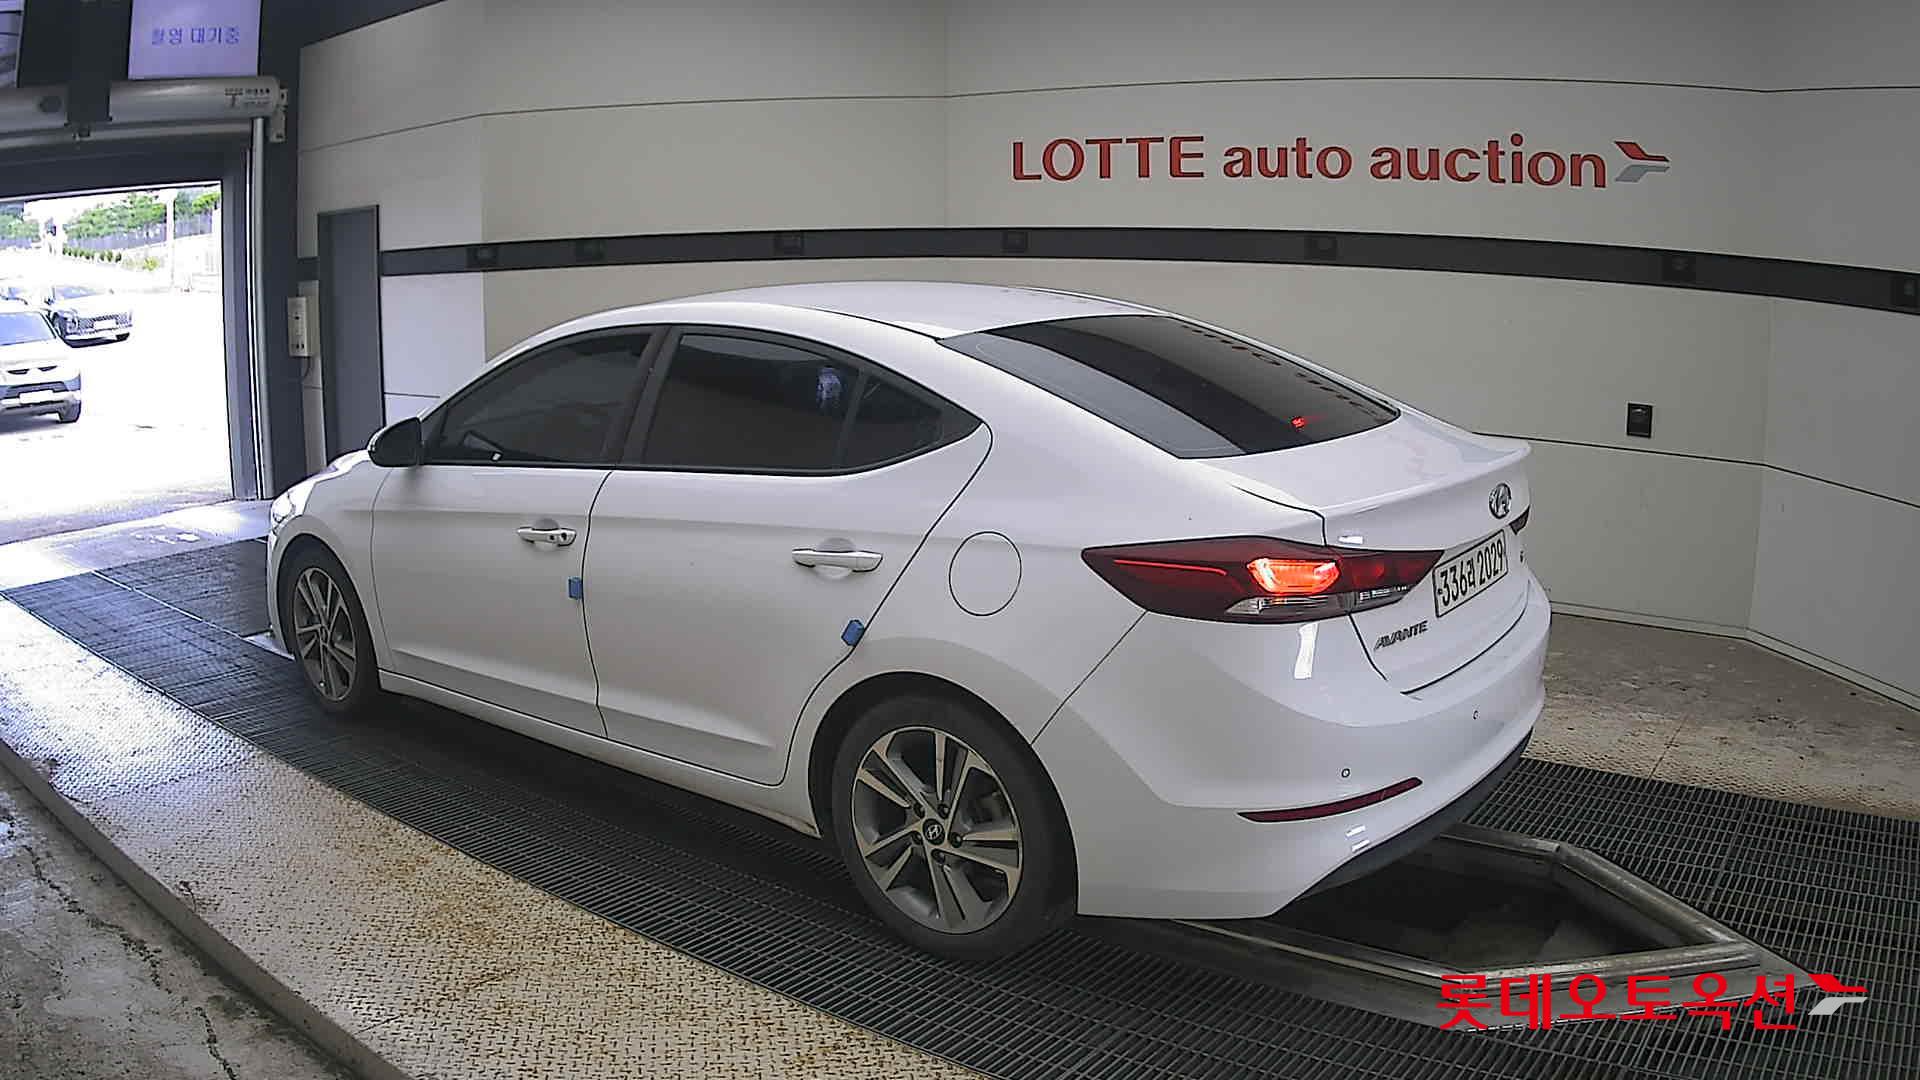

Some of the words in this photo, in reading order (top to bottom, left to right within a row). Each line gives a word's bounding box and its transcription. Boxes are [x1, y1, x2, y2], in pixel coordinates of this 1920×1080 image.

[191, 26, 241, 45] 대기중
[1012, 136, 1206, 182] LOTTE
[1222, 136, 1355, 180] auto
[1369, 133, 1607, 188] auction
[1477, 538, 1504, 586] 2029
[1374, 620, 1429, 651] AVANTE
